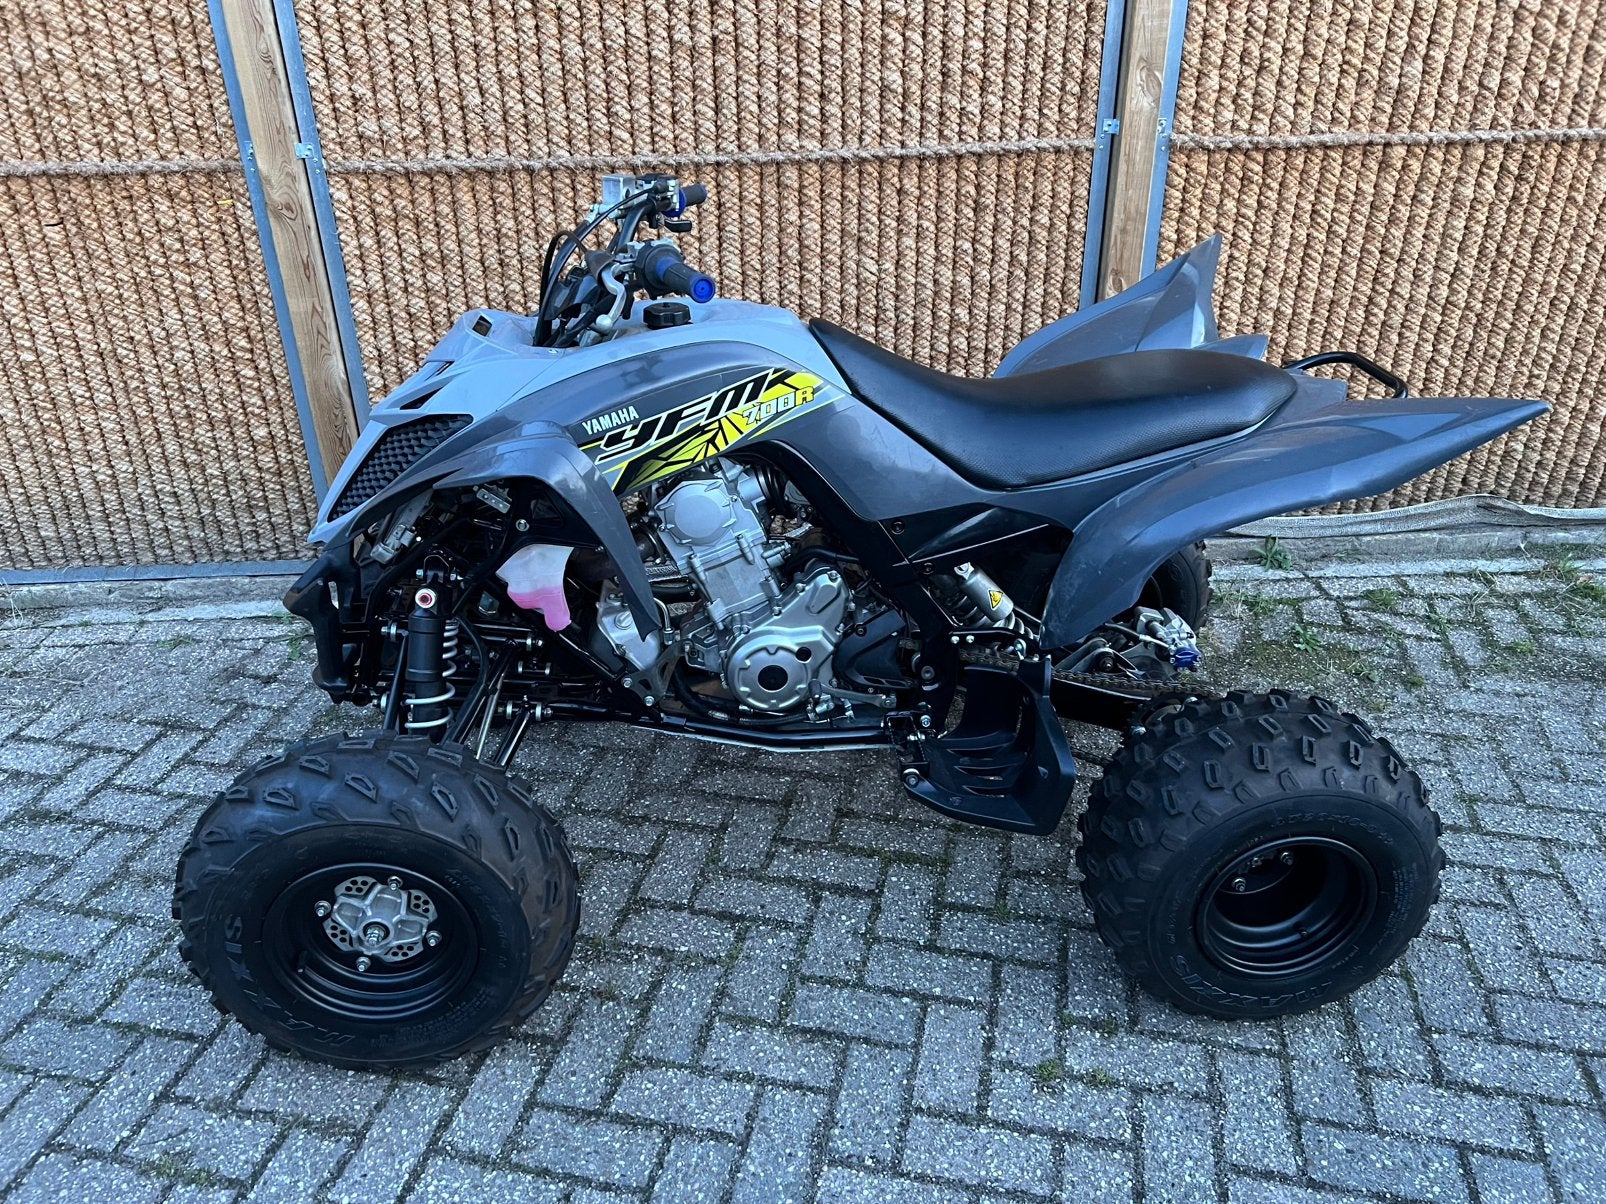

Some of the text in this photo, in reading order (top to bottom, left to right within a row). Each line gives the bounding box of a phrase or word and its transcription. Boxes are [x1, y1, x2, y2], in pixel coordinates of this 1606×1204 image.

[581, 405, 640, 435] YAMAHA
[594, 367, 775, 466] YFM
[742, 386, 815, 426] 700R
[223, 913, 356, 1047] MAXXIS
[1170, 955, 1333, 1009] MAXXIS
